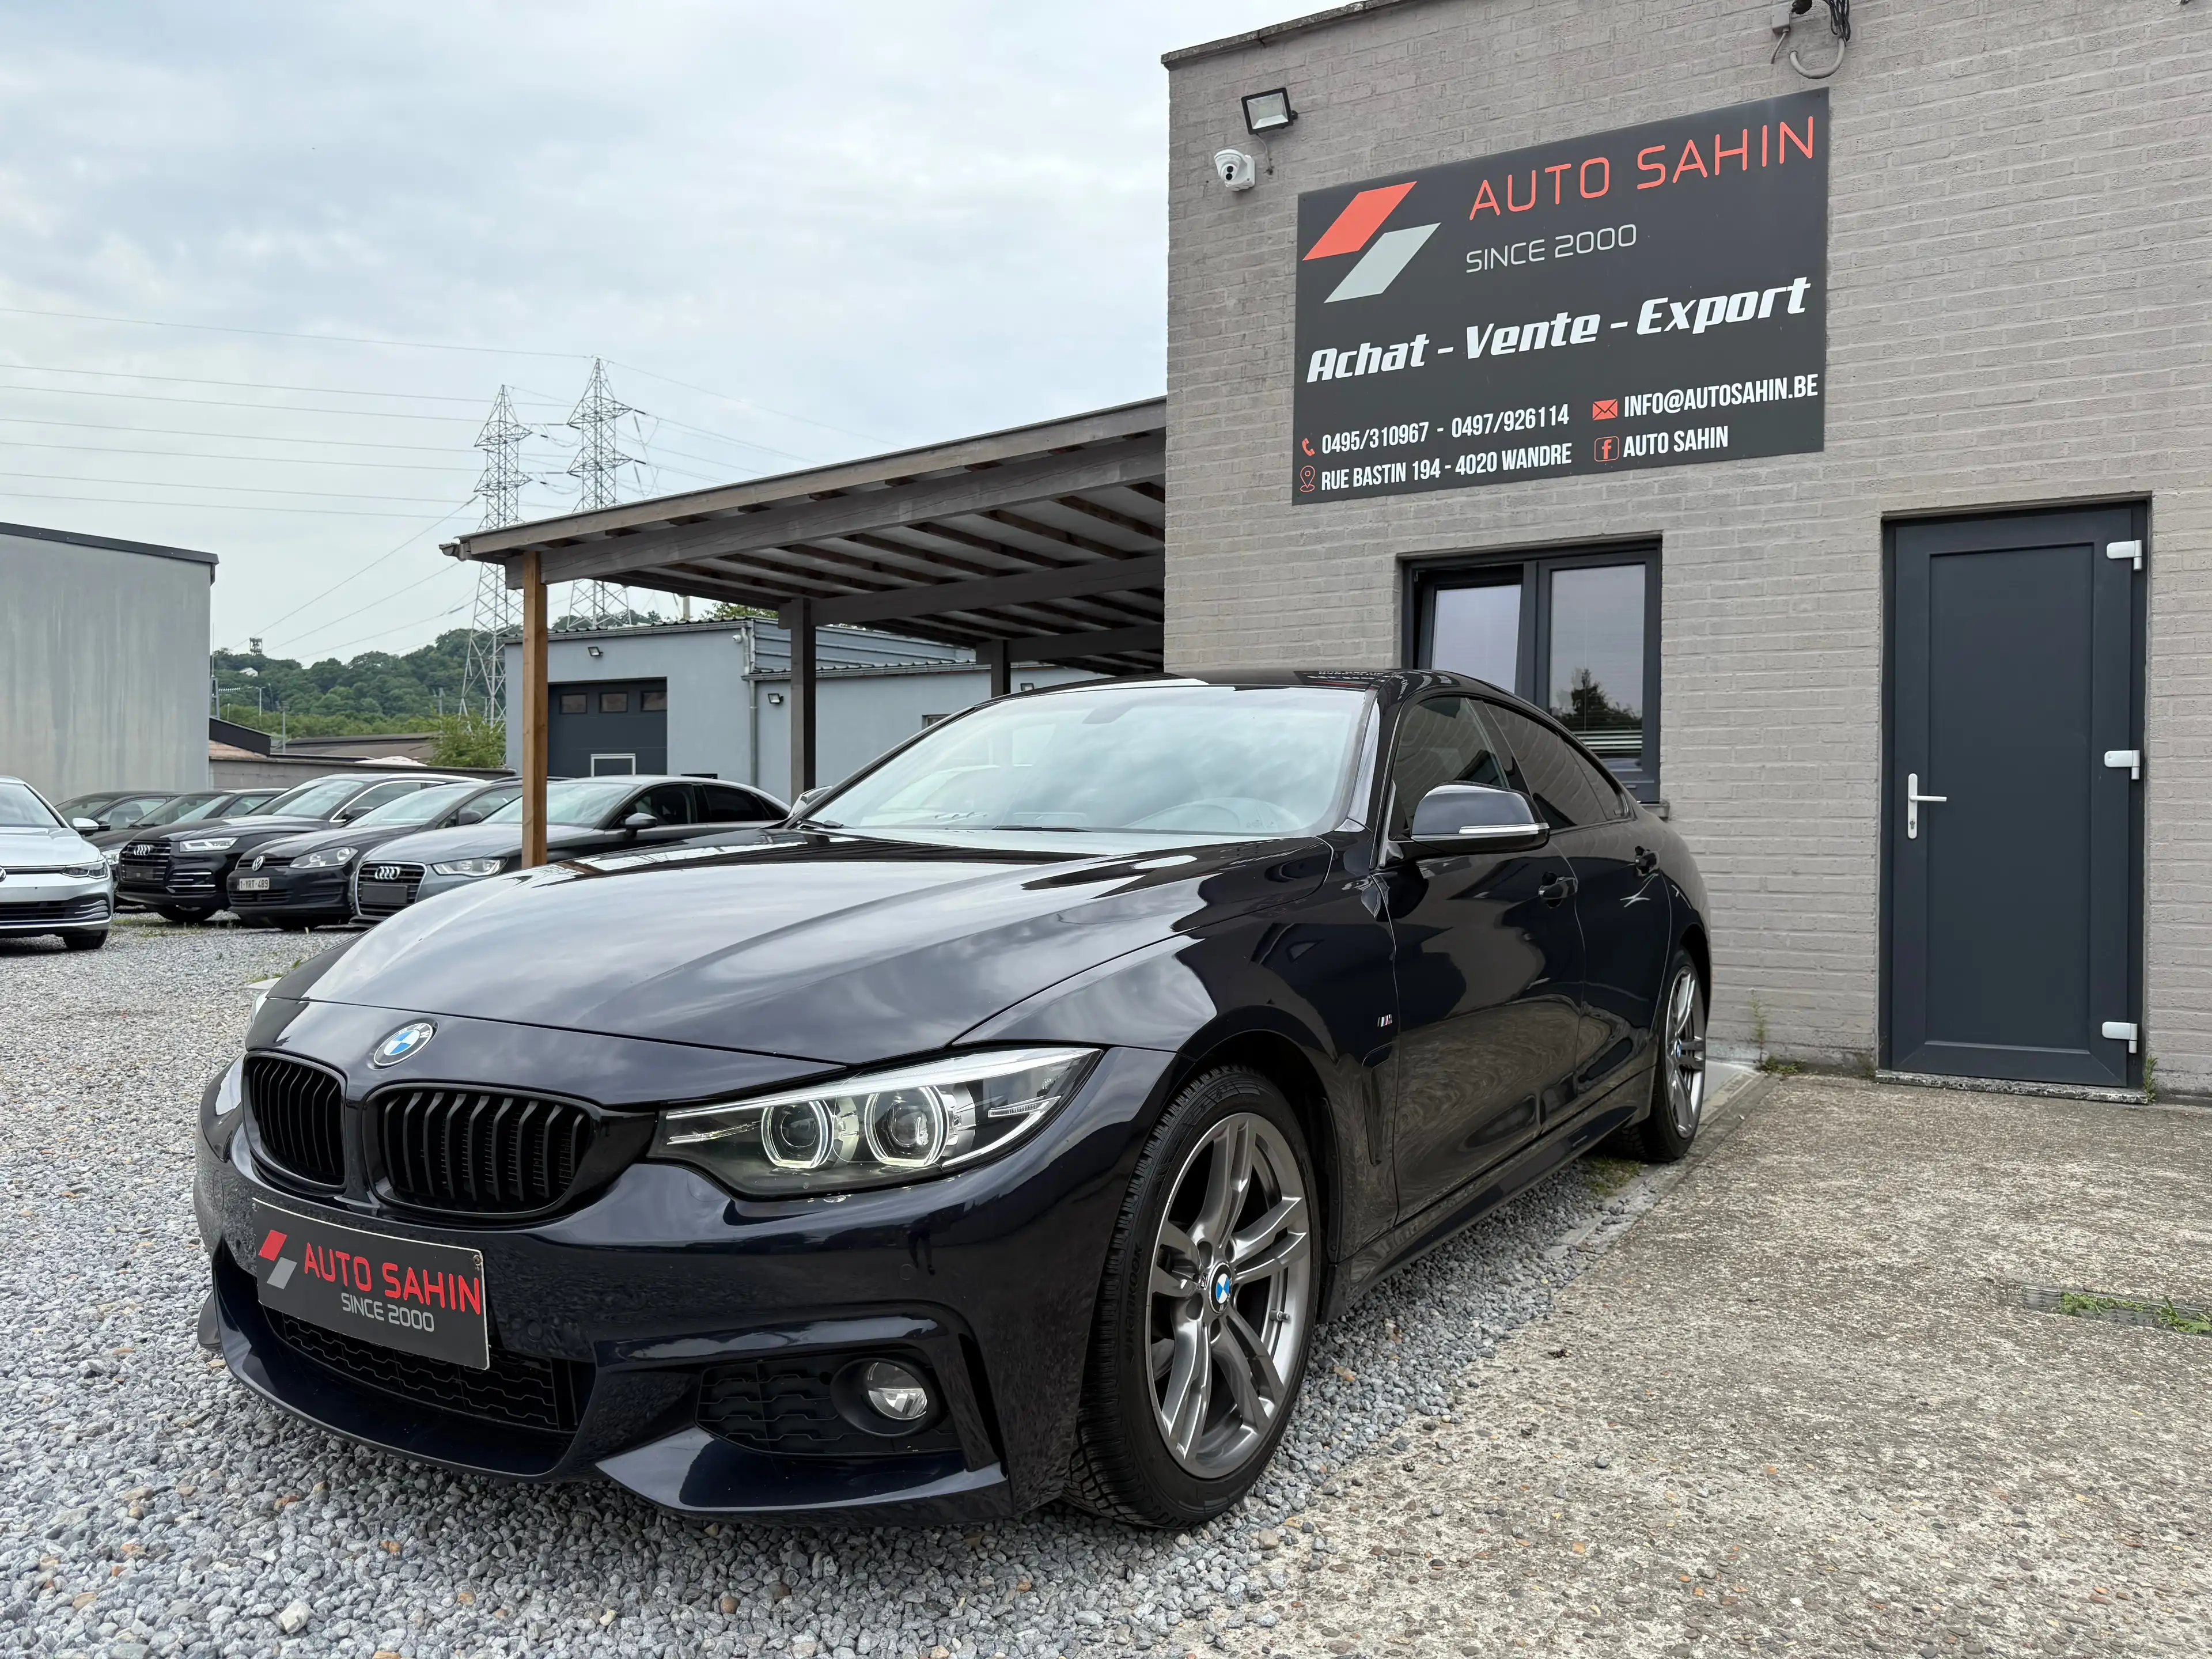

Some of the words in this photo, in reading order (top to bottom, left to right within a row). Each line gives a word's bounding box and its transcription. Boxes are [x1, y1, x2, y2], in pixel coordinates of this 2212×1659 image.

[1469, 157, 1609, 221] AUTO
[1637, 116, 1813, 190] SAHIN
[1466, 238, 1546, 273] SINCE
[1555, 224, 1637, 258] 2000
[1306, 334, 1430, 383] Achat
[1466, 312, 1601, 359] Vente
[1637, 276, 1811, 335] Export
[1624, 373, 1819, 418] INFO@AUTOSAHIN.BE
[1321, 421, 1429, 454] 0495/310967
[1452, 403, 1570, 438] 0497/926114
[1623, 430, 1669, 458] AUTO
[1673, 425, 1728, 452] SAHIN
[1321, 468, 1350, 491] RUE
[1353, 463, 1406, 487] BASTIN
[1411, 458, 1441, 481] 194
[1455, 451, 1498, 475] 4020
[1501, 442, 1572, 471] WANDRE
[304, 1242, 372, 1292] AUTO
[381, 1262, 481, 1315] SAHIN
[341, 1292, 385, 1321] SINCE
[387, 1304, 435, 1332] 2000
